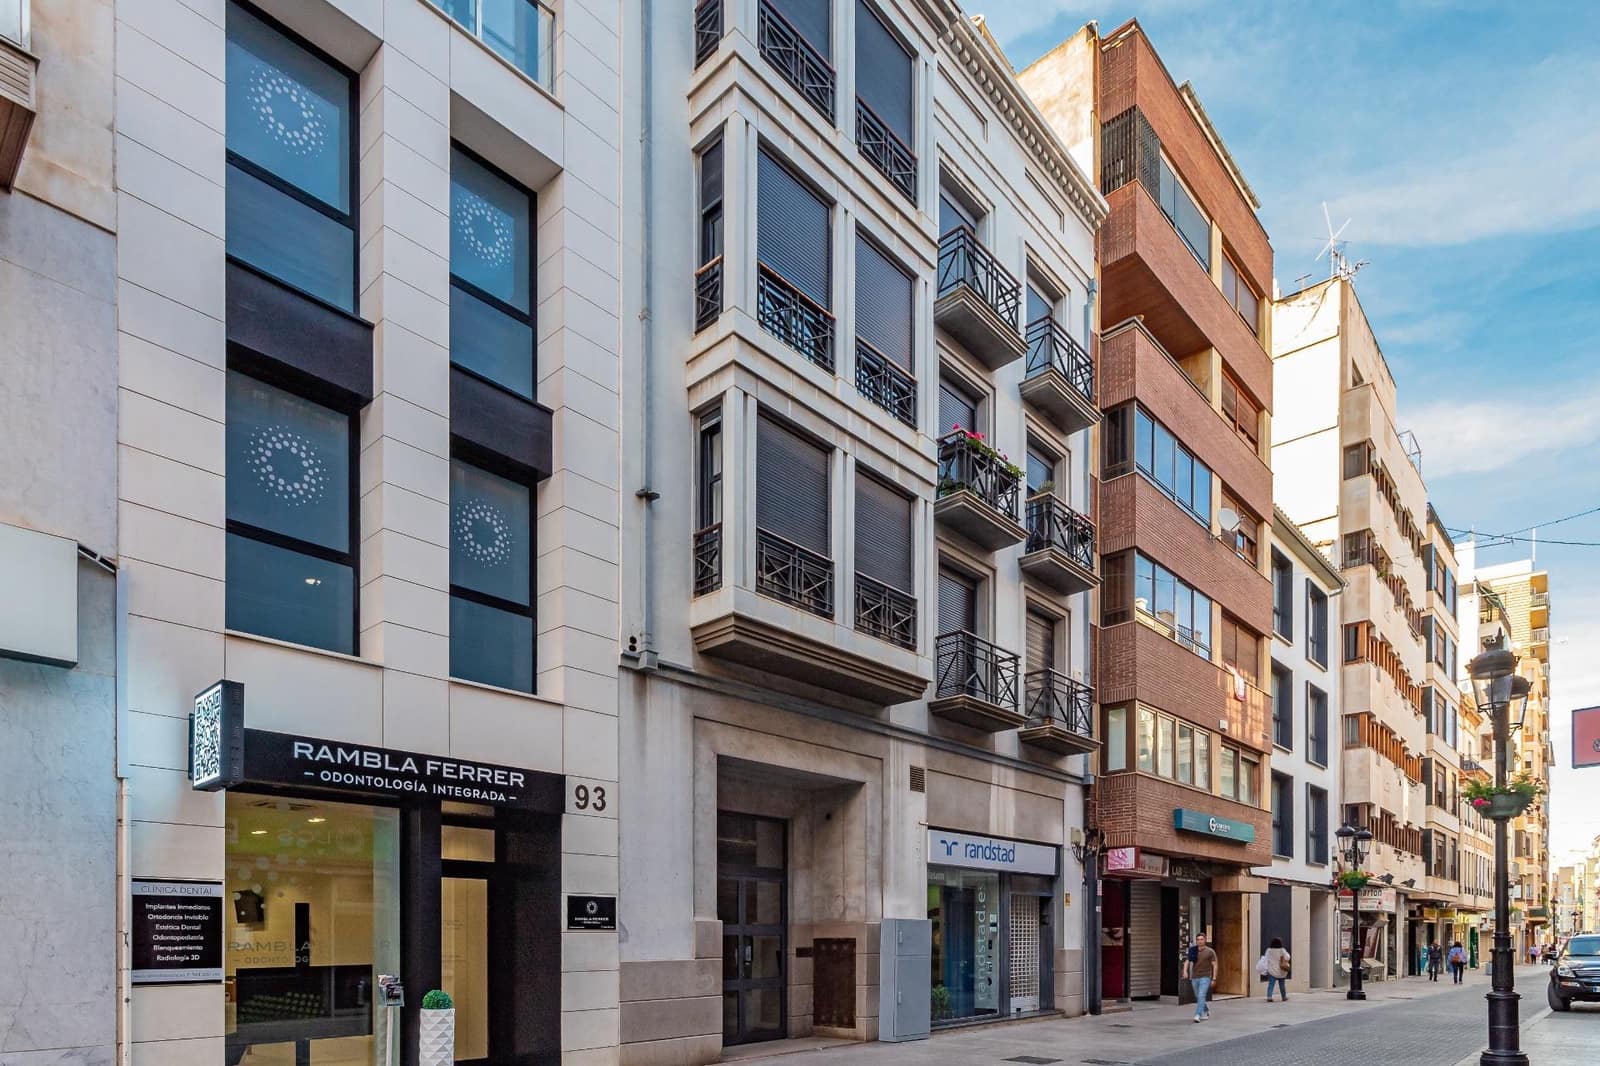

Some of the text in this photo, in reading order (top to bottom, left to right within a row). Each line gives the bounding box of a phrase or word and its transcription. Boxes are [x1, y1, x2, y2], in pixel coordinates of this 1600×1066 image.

[293, 741, 525, 788] RAMBLA FERRER
[320, 769, 506, 802] ODONTOLOGÍA INTEGRADA
[574, 784, 607, 811] 93
[964, 840, 1016, 863] randstad
[141, 885, 212, 895] CLÍNICA DENTAL
[145, 903, 177, 911] Implantes
[153, 944, 204, 952] Blanqueamiento
